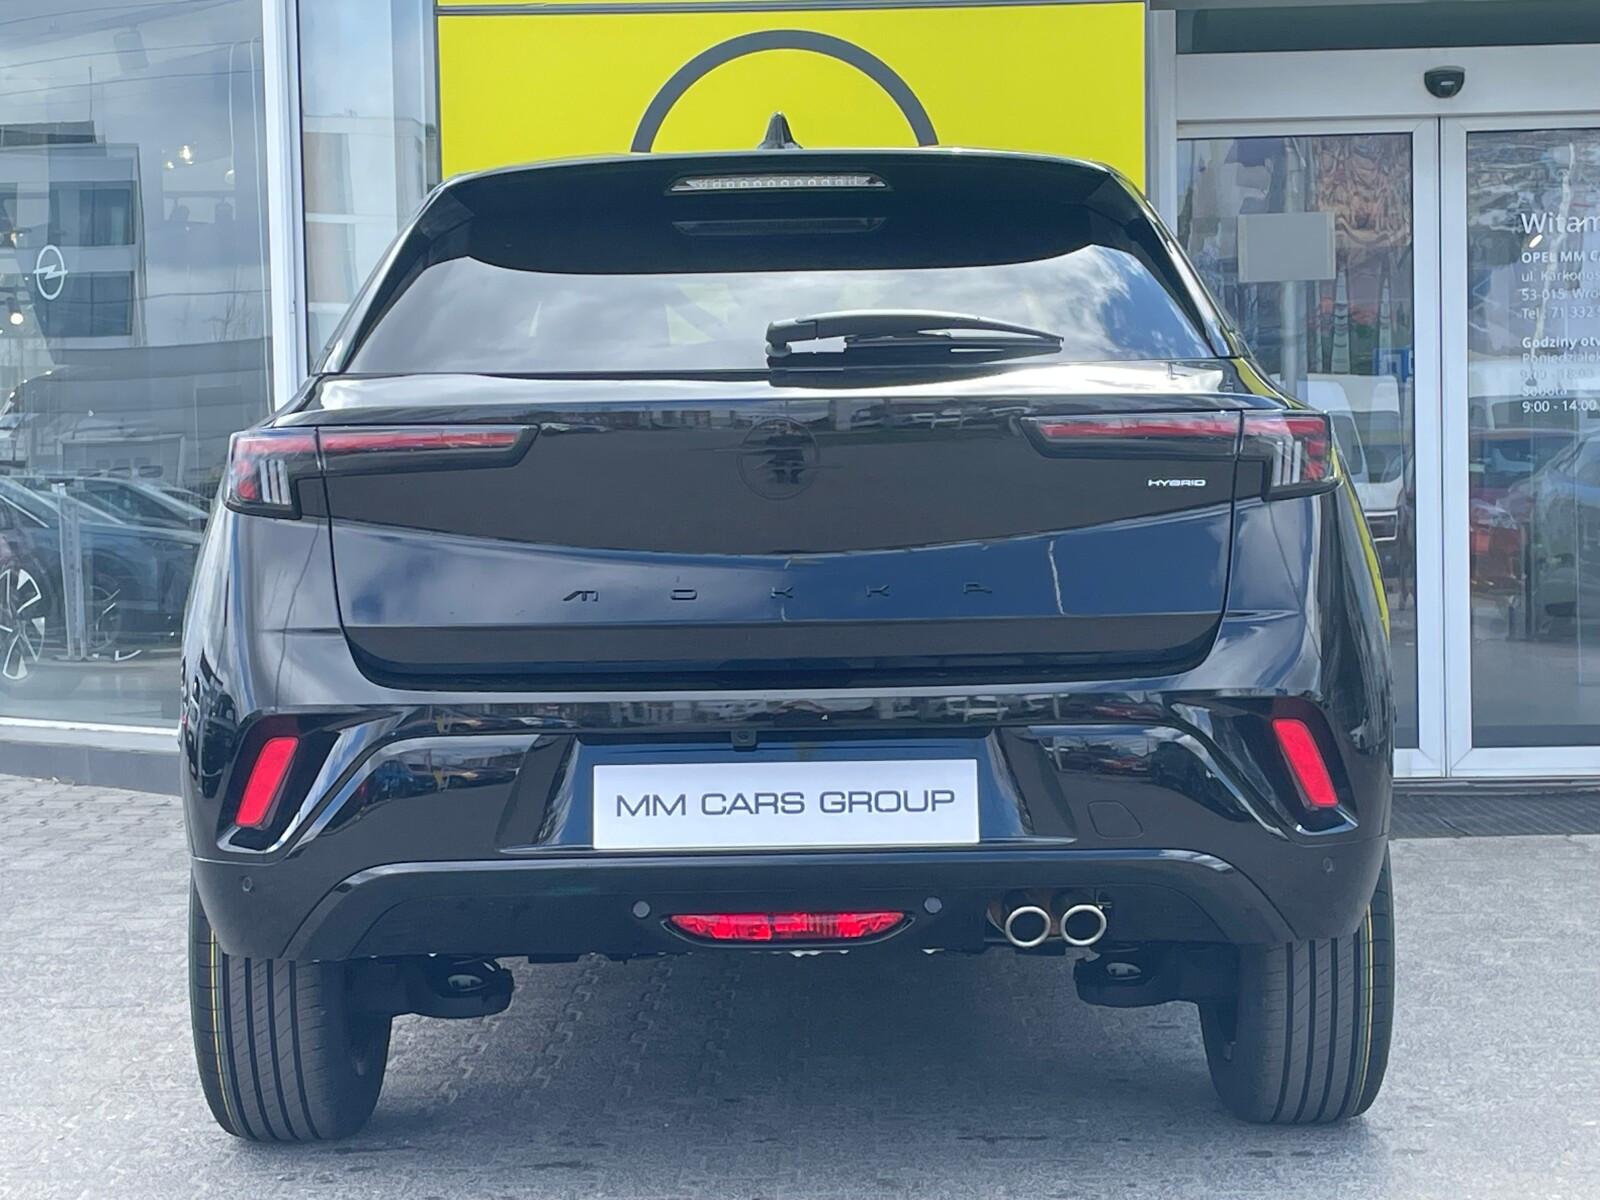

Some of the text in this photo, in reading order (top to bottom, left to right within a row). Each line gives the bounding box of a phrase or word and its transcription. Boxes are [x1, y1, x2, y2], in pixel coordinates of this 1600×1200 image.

[1522, 252, 1556, 263] OPEL
[1560, 251, 1586, 263] MM
[1521, 287, 1600, 301] 53-015 Wro
[1570, 305, 1593, 318] 332
[1522, 336, 1577, 350] Godziny
[1522, 400, 1550, 413] 9:00
[1562, 399, 1597, 412] 14:00
[1148, 479, 1206, 487] HYBRID
[616, 789, 956, 817] MM CARS GROUP
